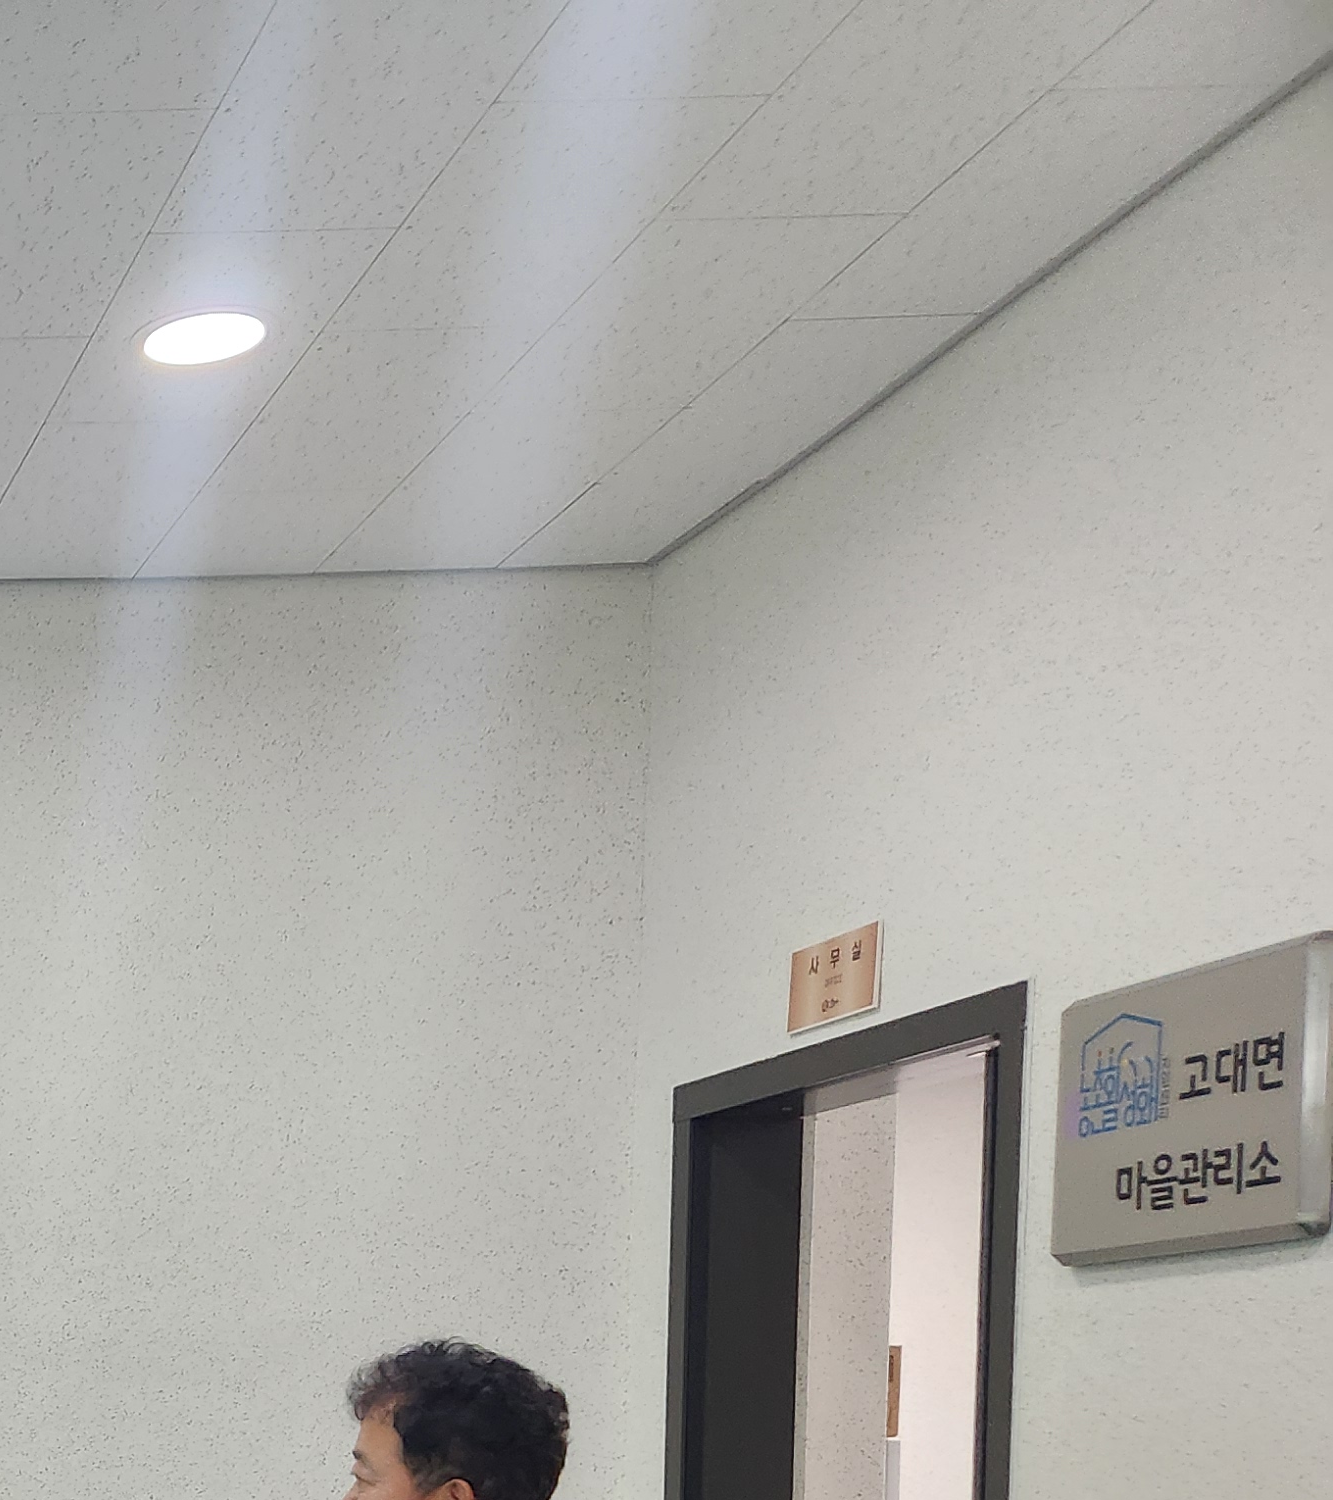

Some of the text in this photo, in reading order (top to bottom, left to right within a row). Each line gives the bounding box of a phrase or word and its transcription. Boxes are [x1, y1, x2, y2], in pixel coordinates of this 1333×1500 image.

[808, 940, 862, 975] 사무실
[1179, 1031, 1285, 1100] 고대면
[1115, 1140, 1281, 1211] 마을관리소
